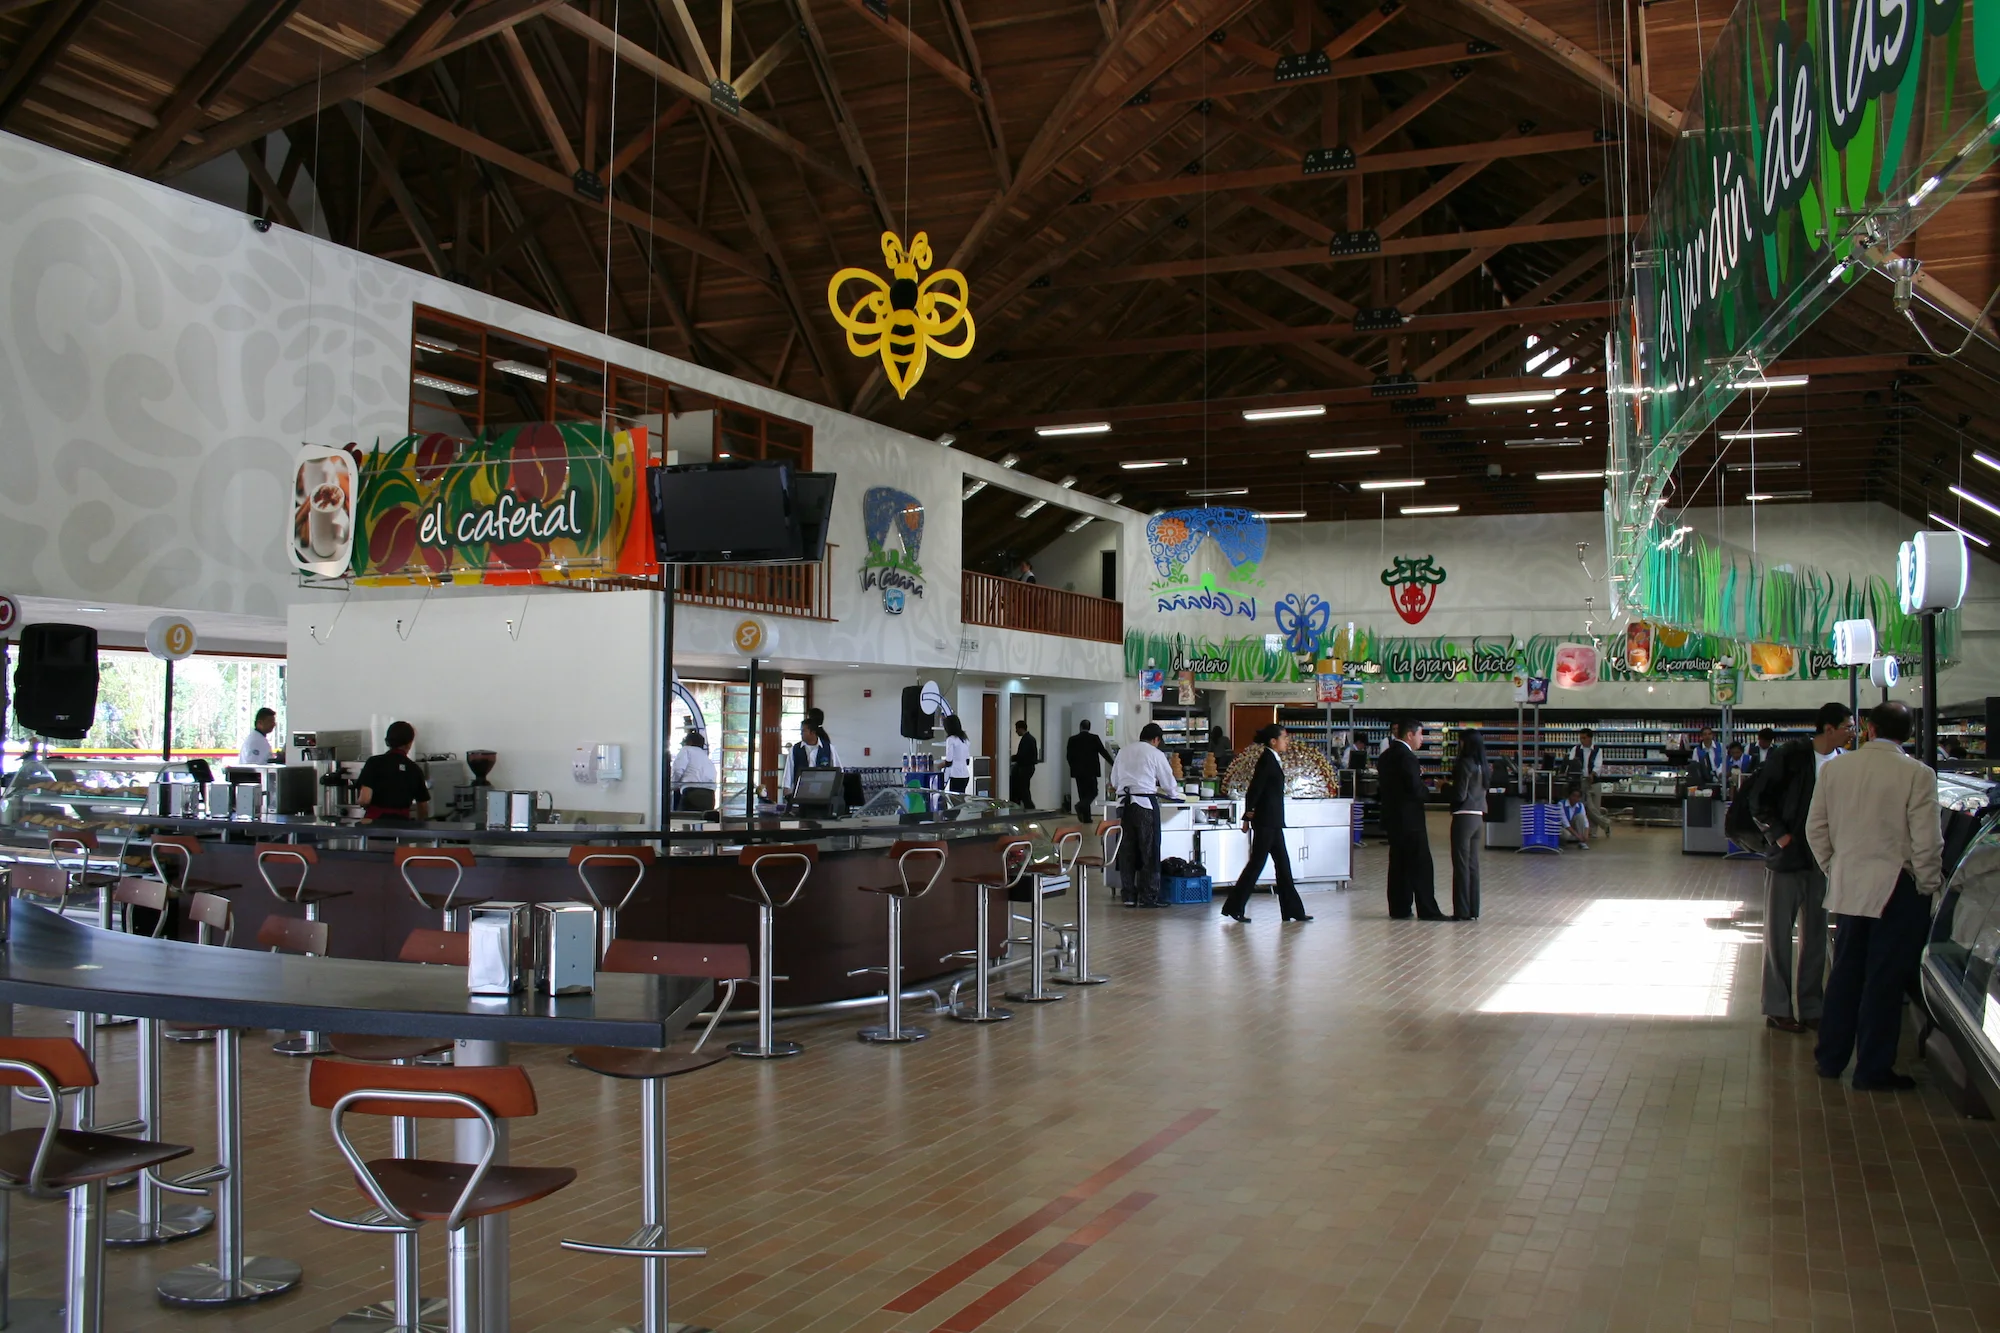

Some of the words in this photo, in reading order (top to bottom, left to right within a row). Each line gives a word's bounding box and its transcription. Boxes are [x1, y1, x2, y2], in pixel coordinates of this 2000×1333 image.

[1659, 248, 1675, 362] el
[1676, 151, 1752, 391] jardín
[1764, 43, 1812, 215] de
[1827, 0, 1908, 127] las
[420, 502, 447, 545] el
[457, 489, 582, 542] cafetal
[173, 627, 186, 650] 9
[741, 626, 758, 646] 8
[1173, 652, 1183, 671] el
[1393, 655, 1410, 673] la
[1414, 656, 1468, 680] granja
